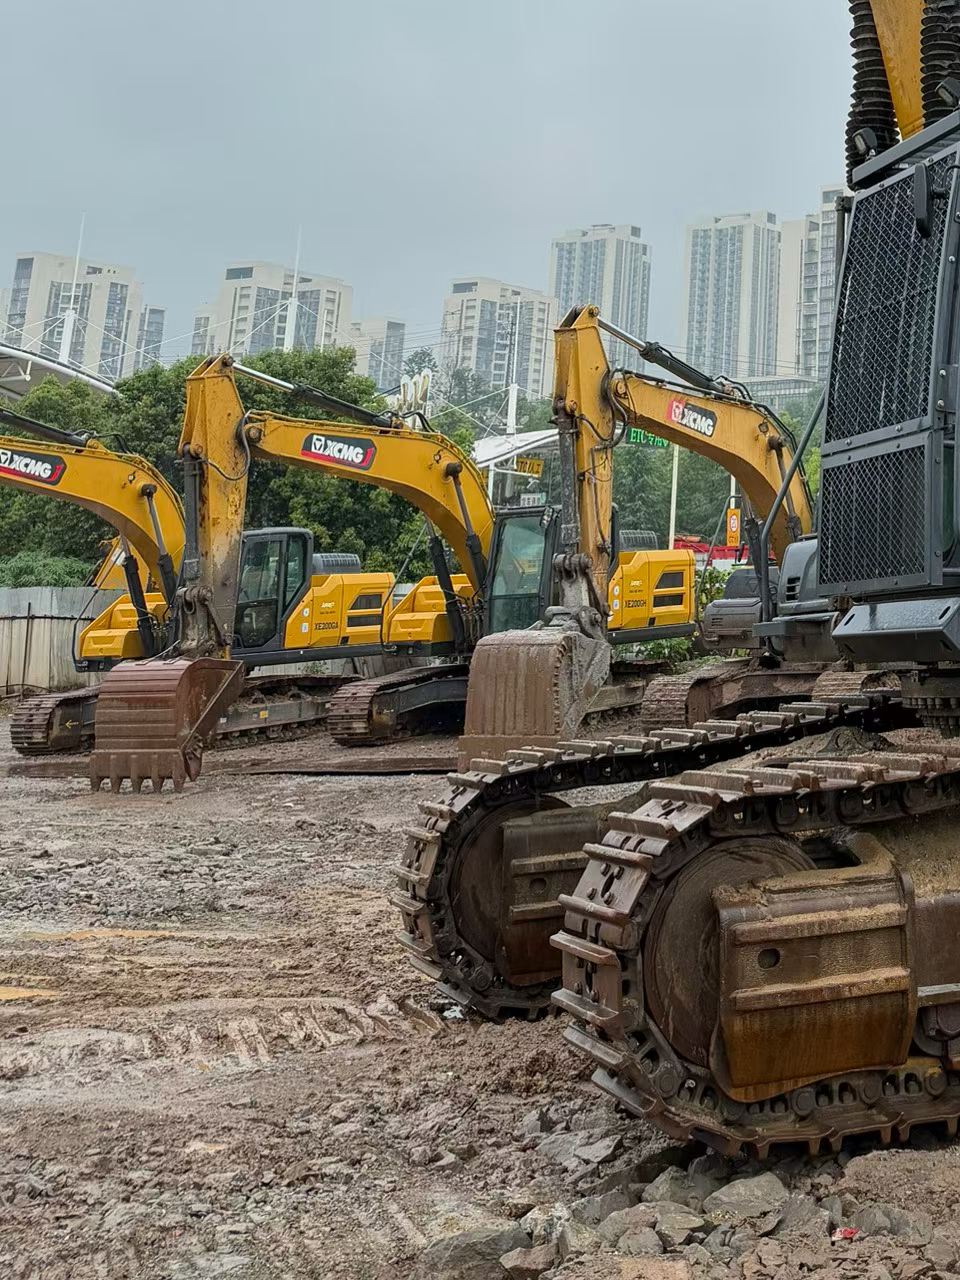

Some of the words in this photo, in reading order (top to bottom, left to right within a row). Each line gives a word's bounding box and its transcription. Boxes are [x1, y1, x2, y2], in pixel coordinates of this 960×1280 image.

[681, 408, 714, 436] XCMG
[324, 440, 364, 463] XCMG
[10, 454, 52, 478] XCMG
